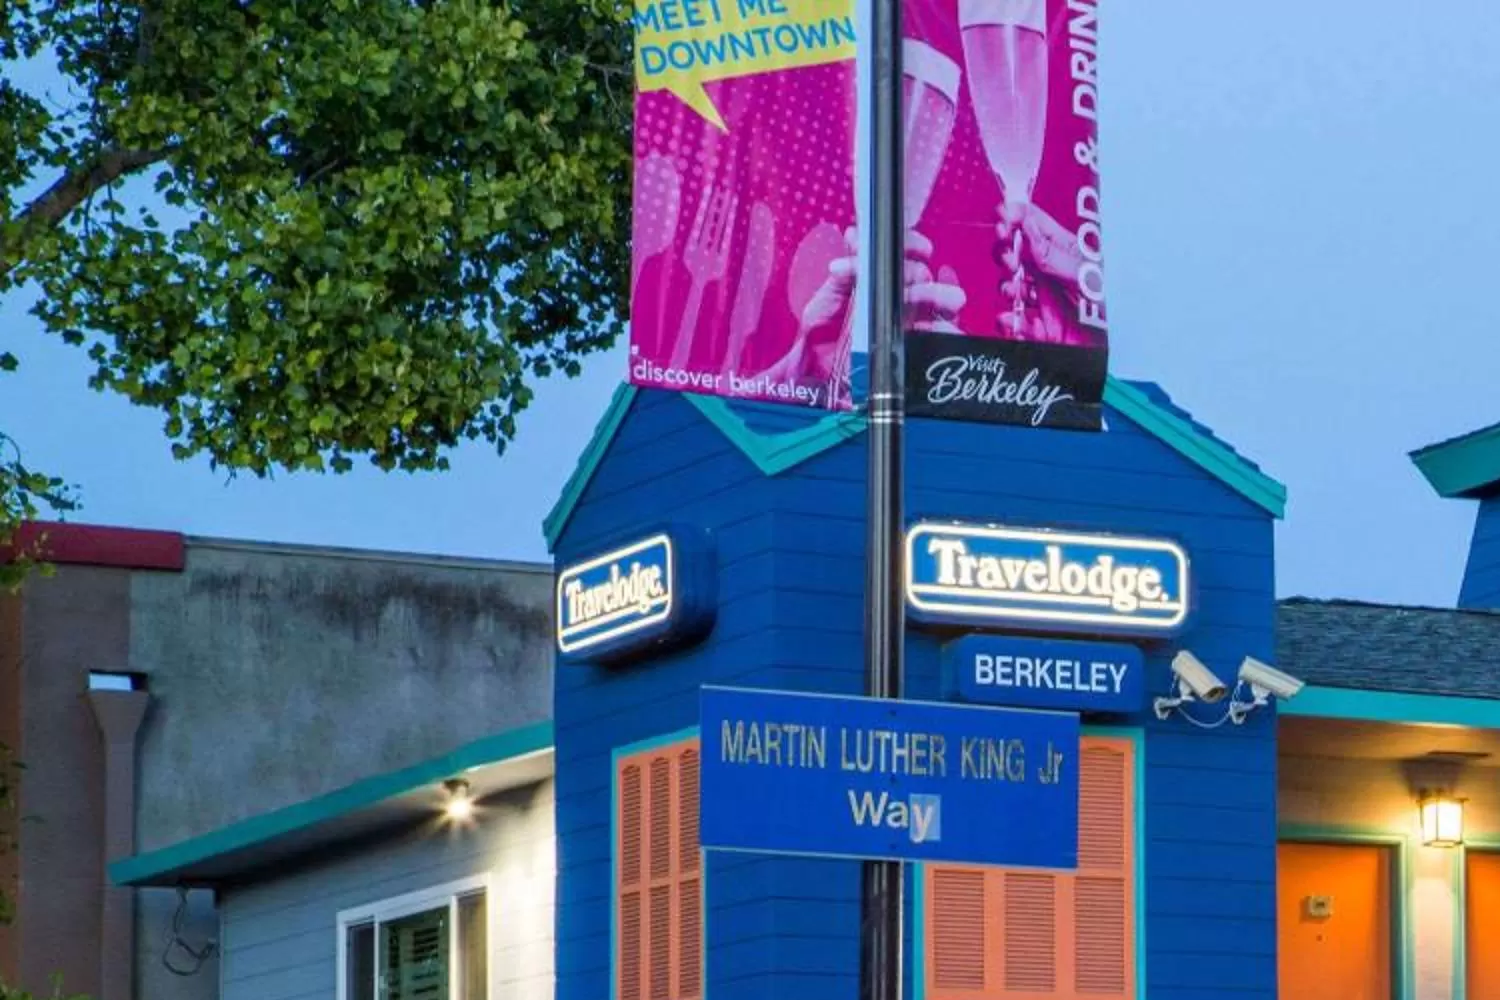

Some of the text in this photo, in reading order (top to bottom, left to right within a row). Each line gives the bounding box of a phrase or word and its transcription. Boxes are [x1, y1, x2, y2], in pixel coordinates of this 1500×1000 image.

[639, 16, 857, 75] DOWNTOWN
[1076, 185, 1108, 330] FOOD
[633, 359, 820, 406] discover berkeley
[925, 355, 1075, 427] Berkeley
[975, 654, 1128, 693] BERKELEY
[720, 719, 826, 768] MARTIN
[840, 728, 947, 777] LUTHER
[960, 735, 1026, 782] KING
[848, 789, 933, 843] Way
